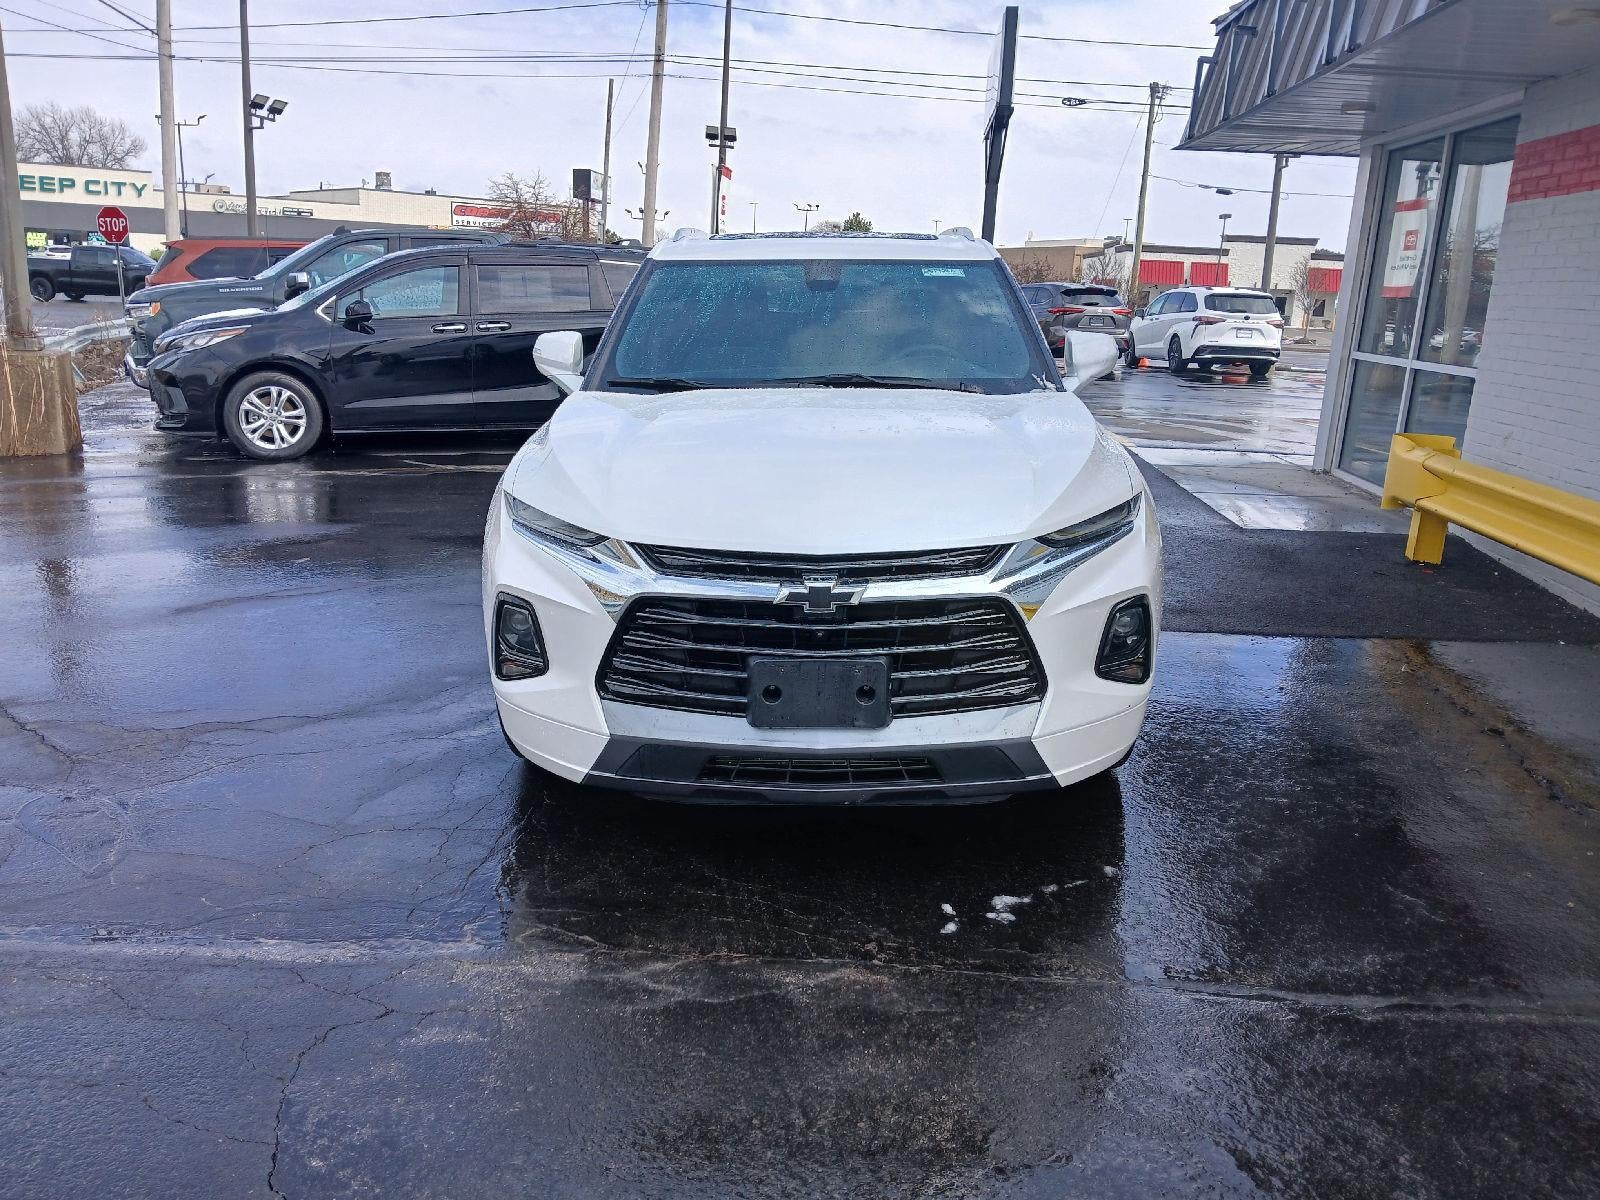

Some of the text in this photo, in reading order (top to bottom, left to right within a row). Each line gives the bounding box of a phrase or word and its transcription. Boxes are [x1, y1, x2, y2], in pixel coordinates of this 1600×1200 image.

[84, 179, 147, 198] CITY
[98, 217, 126, 232] STOP
[218, 286, 263, 294] SILVERADO
